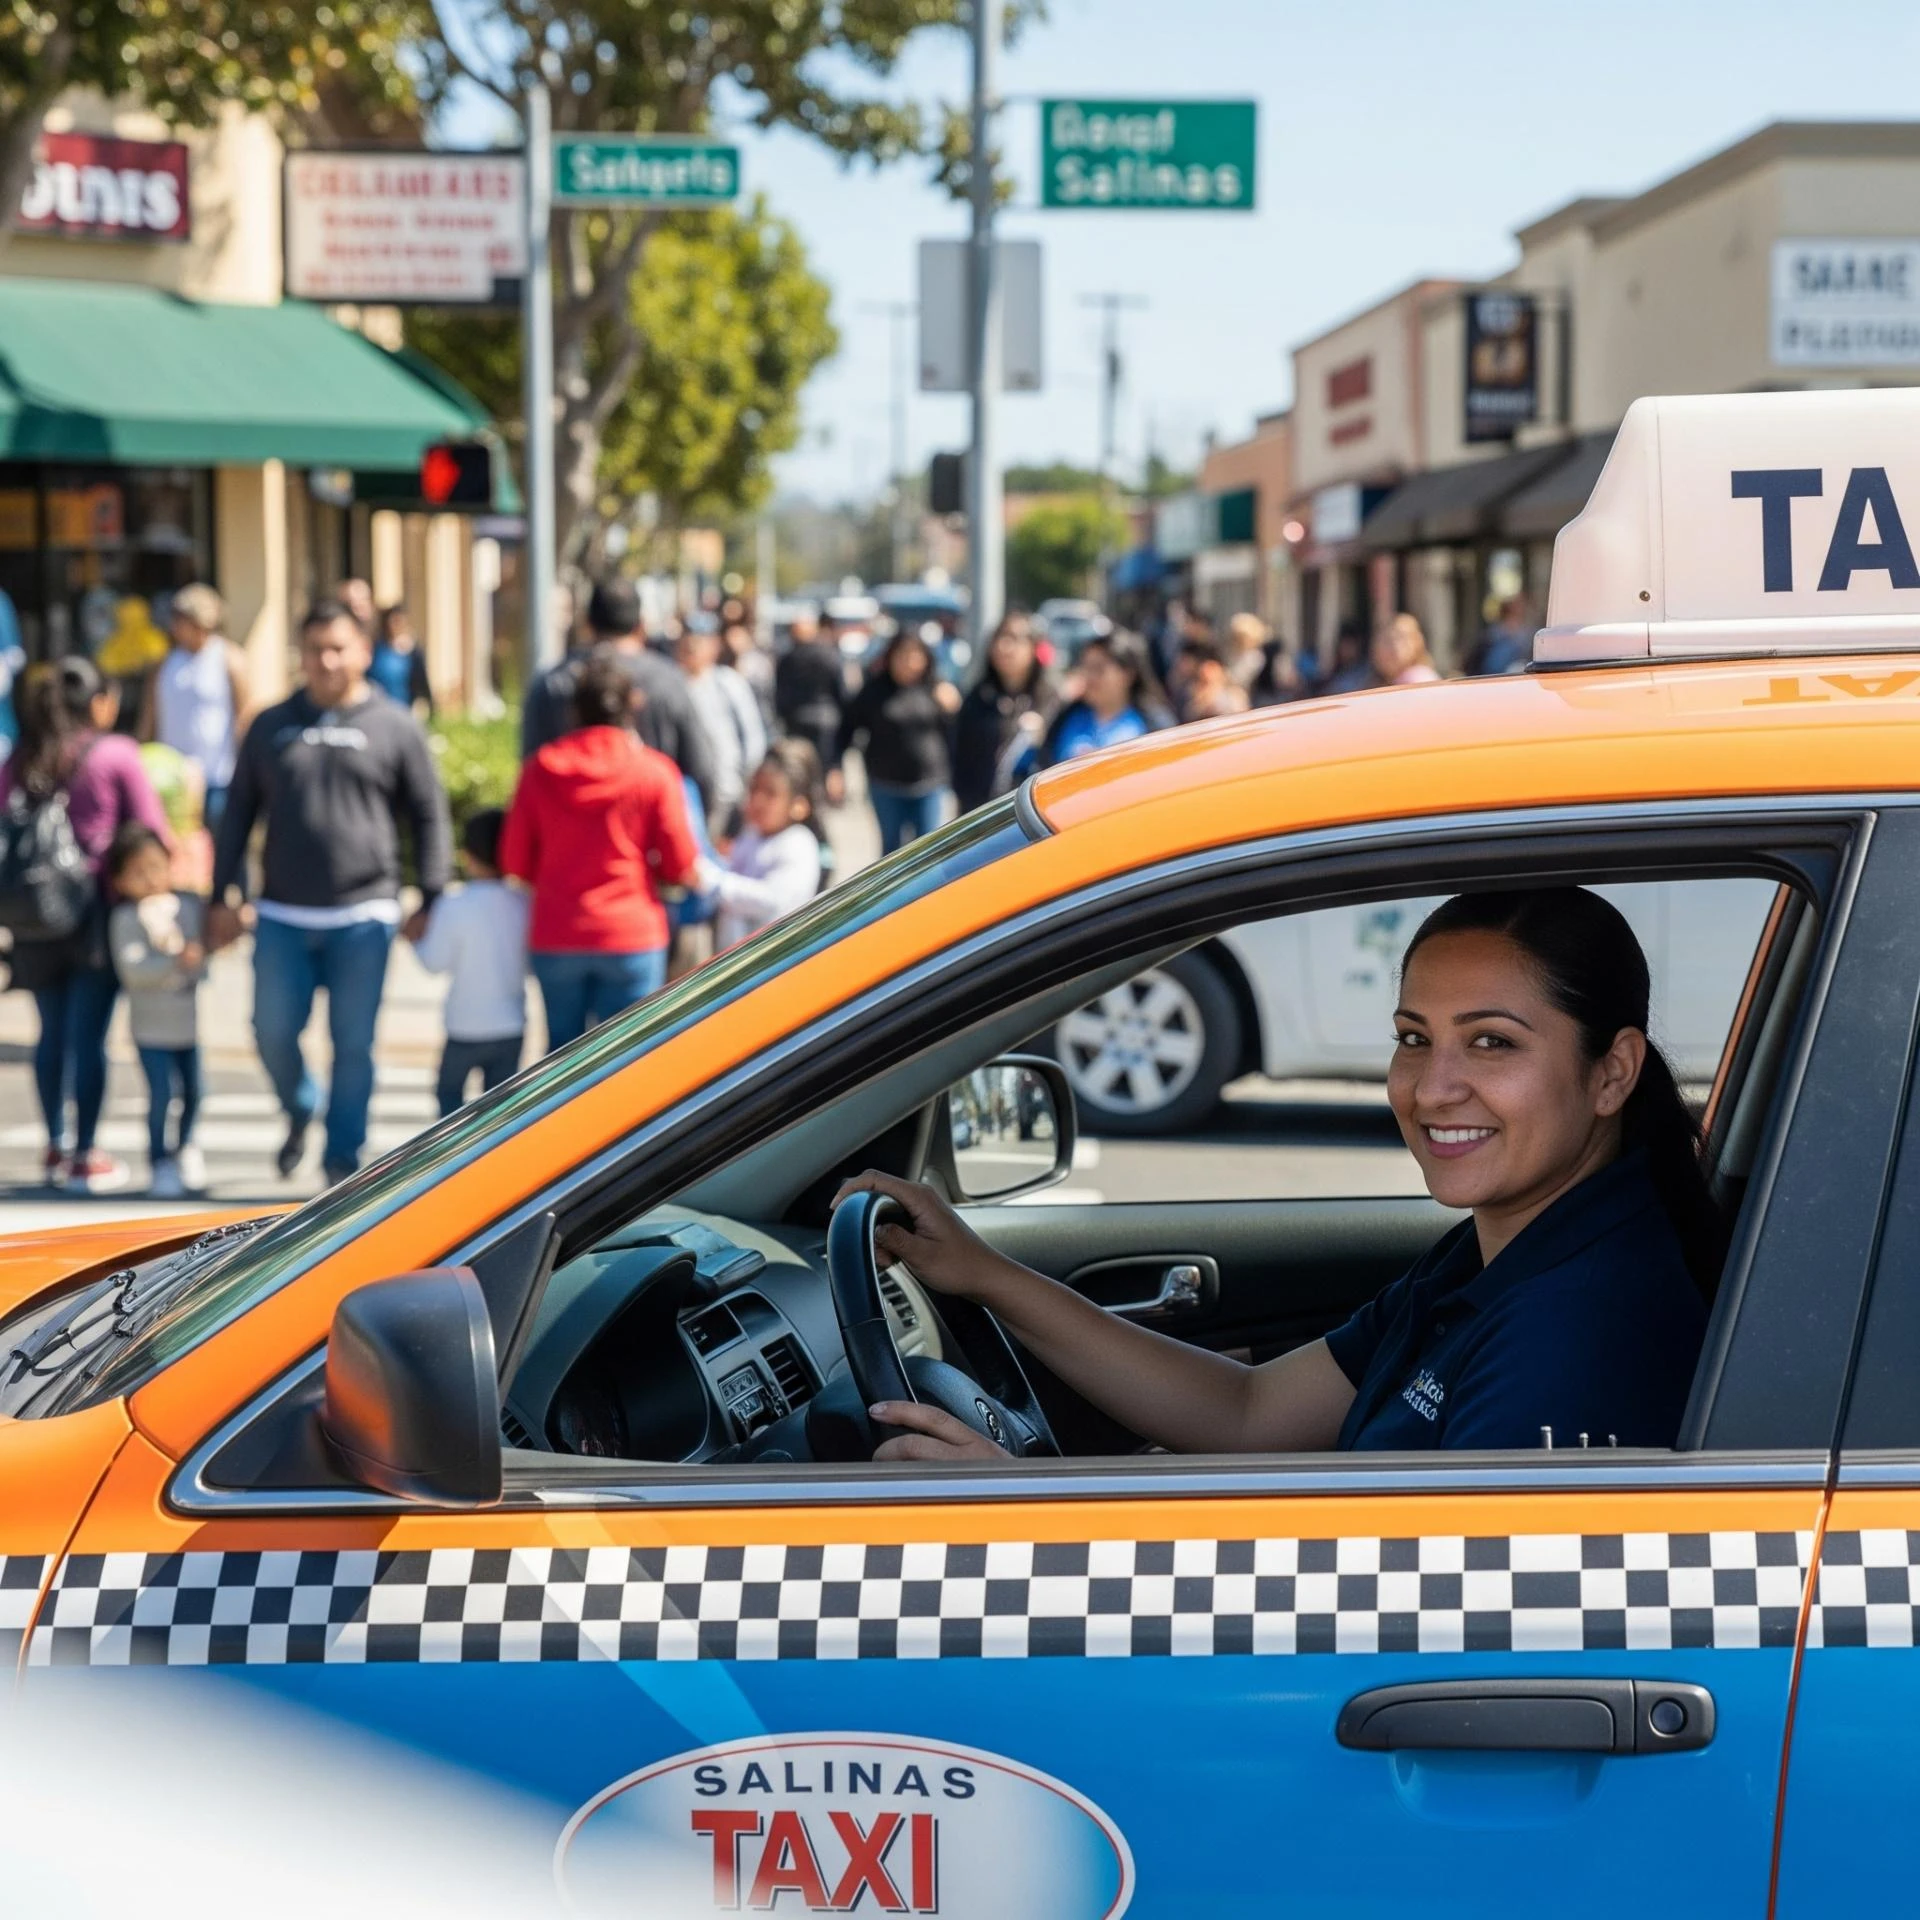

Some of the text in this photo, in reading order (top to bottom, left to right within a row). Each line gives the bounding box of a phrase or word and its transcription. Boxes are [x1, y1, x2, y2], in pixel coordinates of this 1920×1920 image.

[1054, 153, 1243, 204] Salinas
[693, 1761, 976, 1799] SALINAS
[691, 1809, 939, 1914] TAXI
